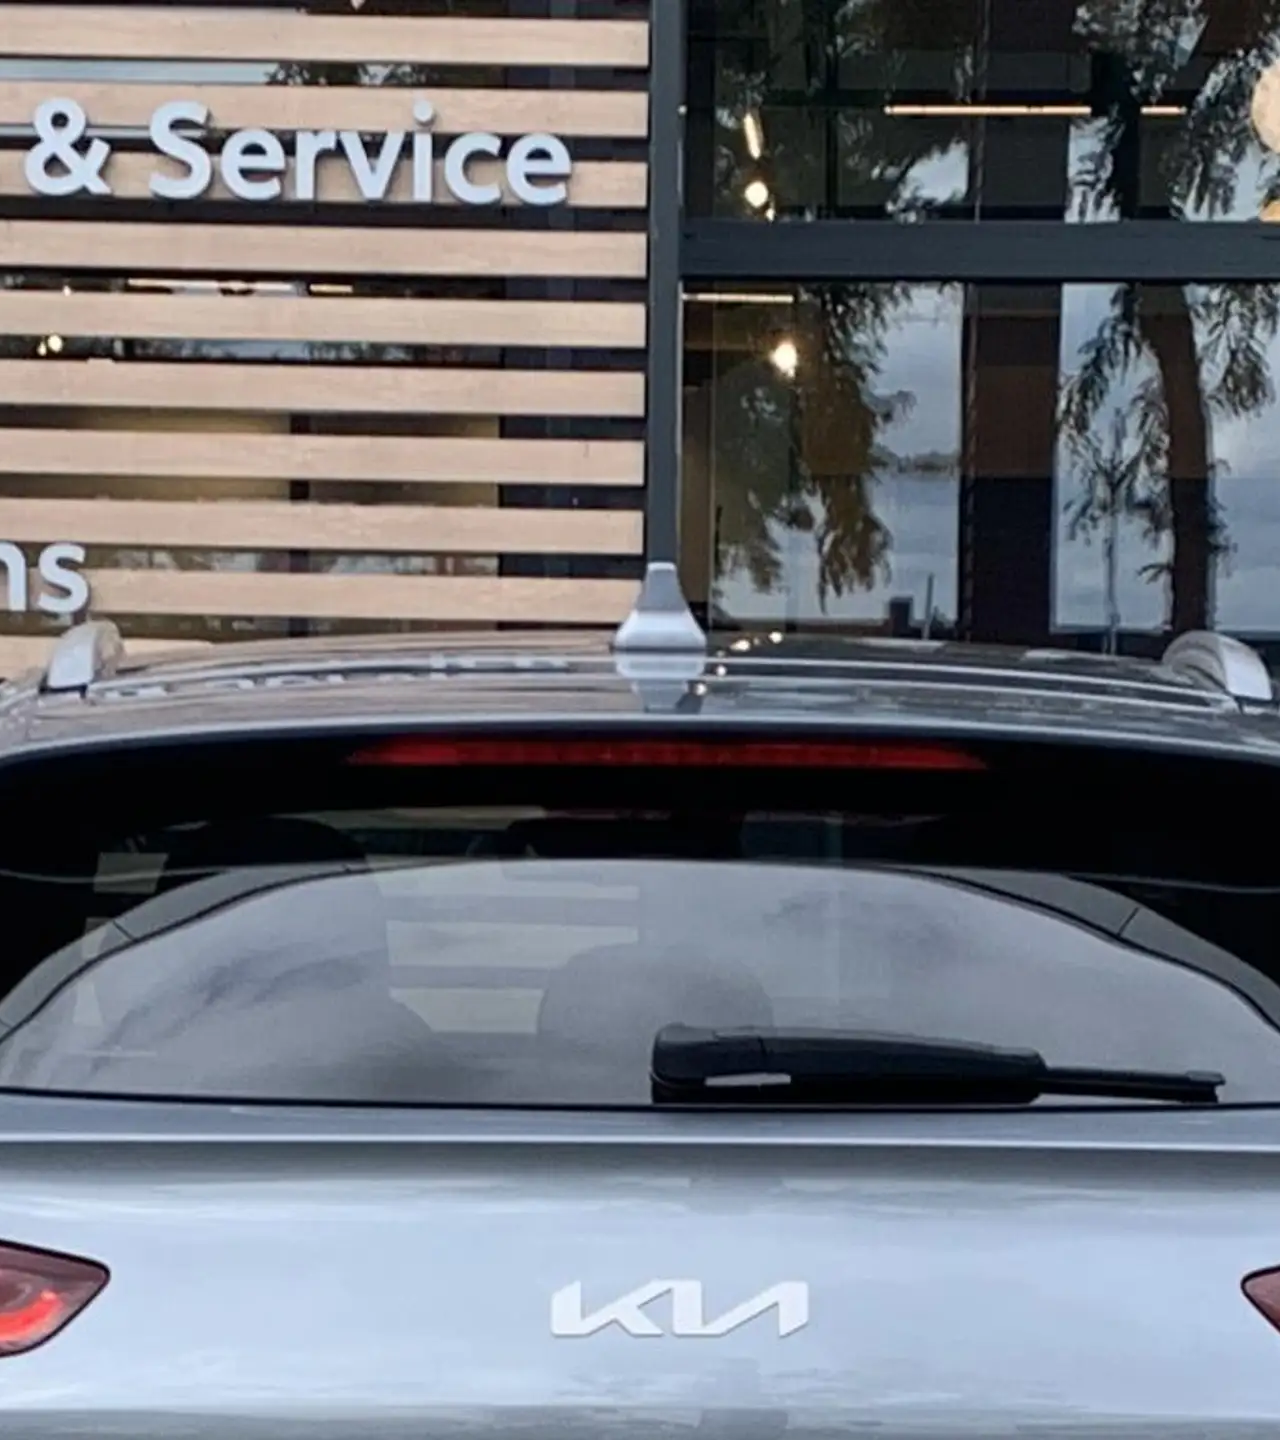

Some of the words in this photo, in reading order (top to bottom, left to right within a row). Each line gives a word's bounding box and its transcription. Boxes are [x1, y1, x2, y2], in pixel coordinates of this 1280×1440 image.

[24, 97, 112, 197] &
[148, 99, 573, 206] Service
[551, 1280, 809, 1338] KIA
